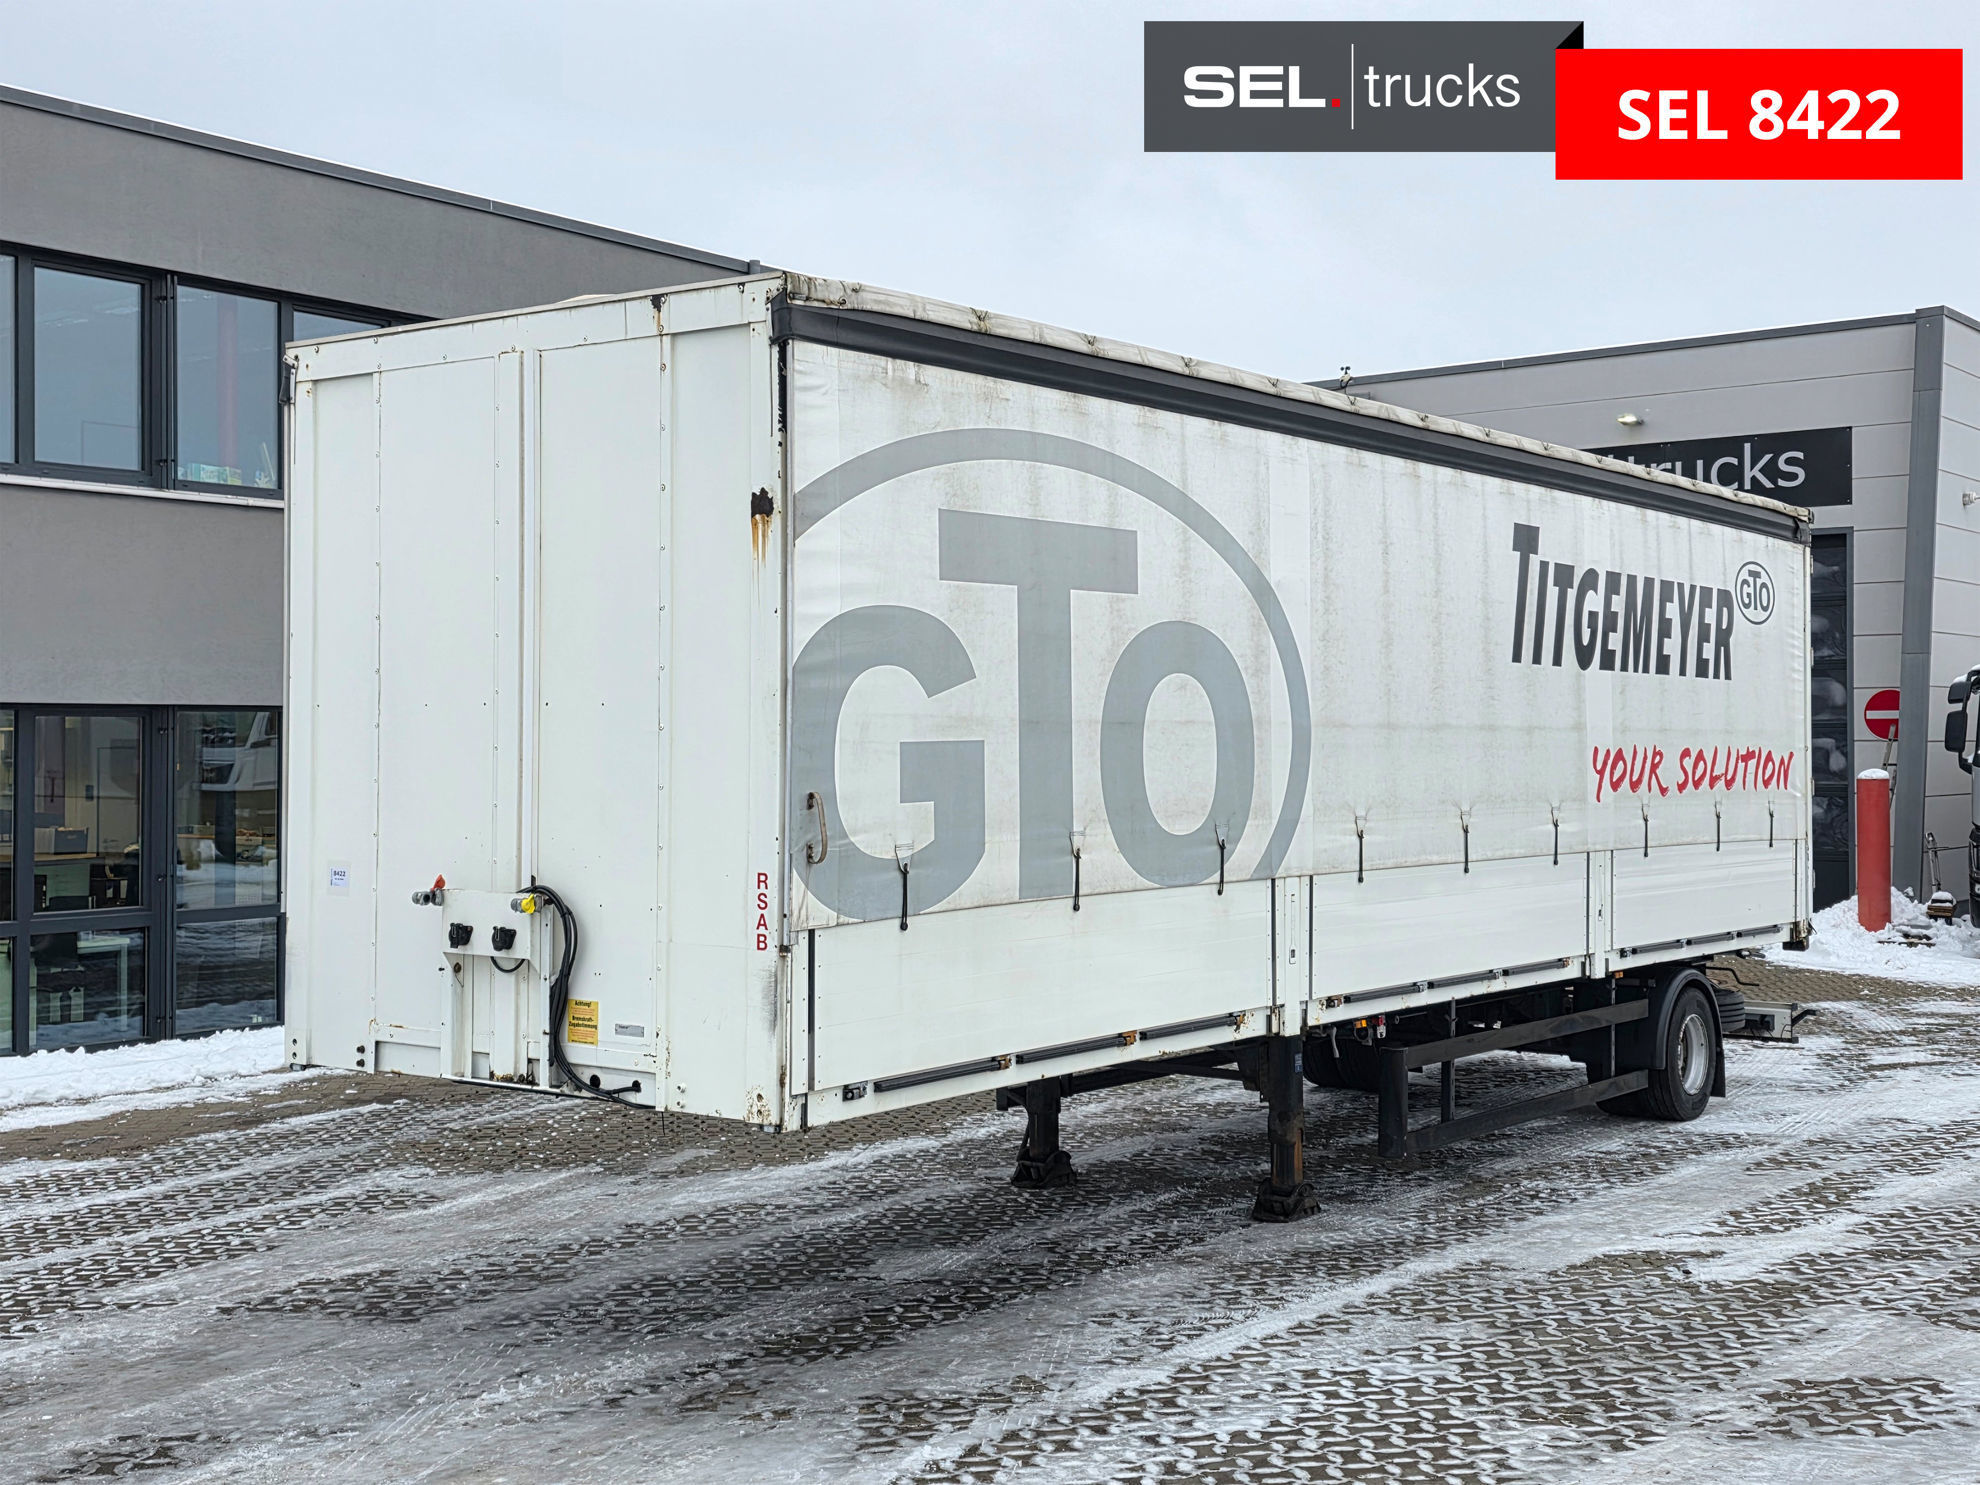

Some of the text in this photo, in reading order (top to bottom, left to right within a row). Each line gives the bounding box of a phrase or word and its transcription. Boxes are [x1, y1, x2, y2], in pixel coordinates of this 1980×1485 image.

[1627, 442, 1806, 491] ucks
[1511, 522, 1735, 681] TITGEMEYER
[1592, 744, 1795, 803] YOUR SOLUTION
